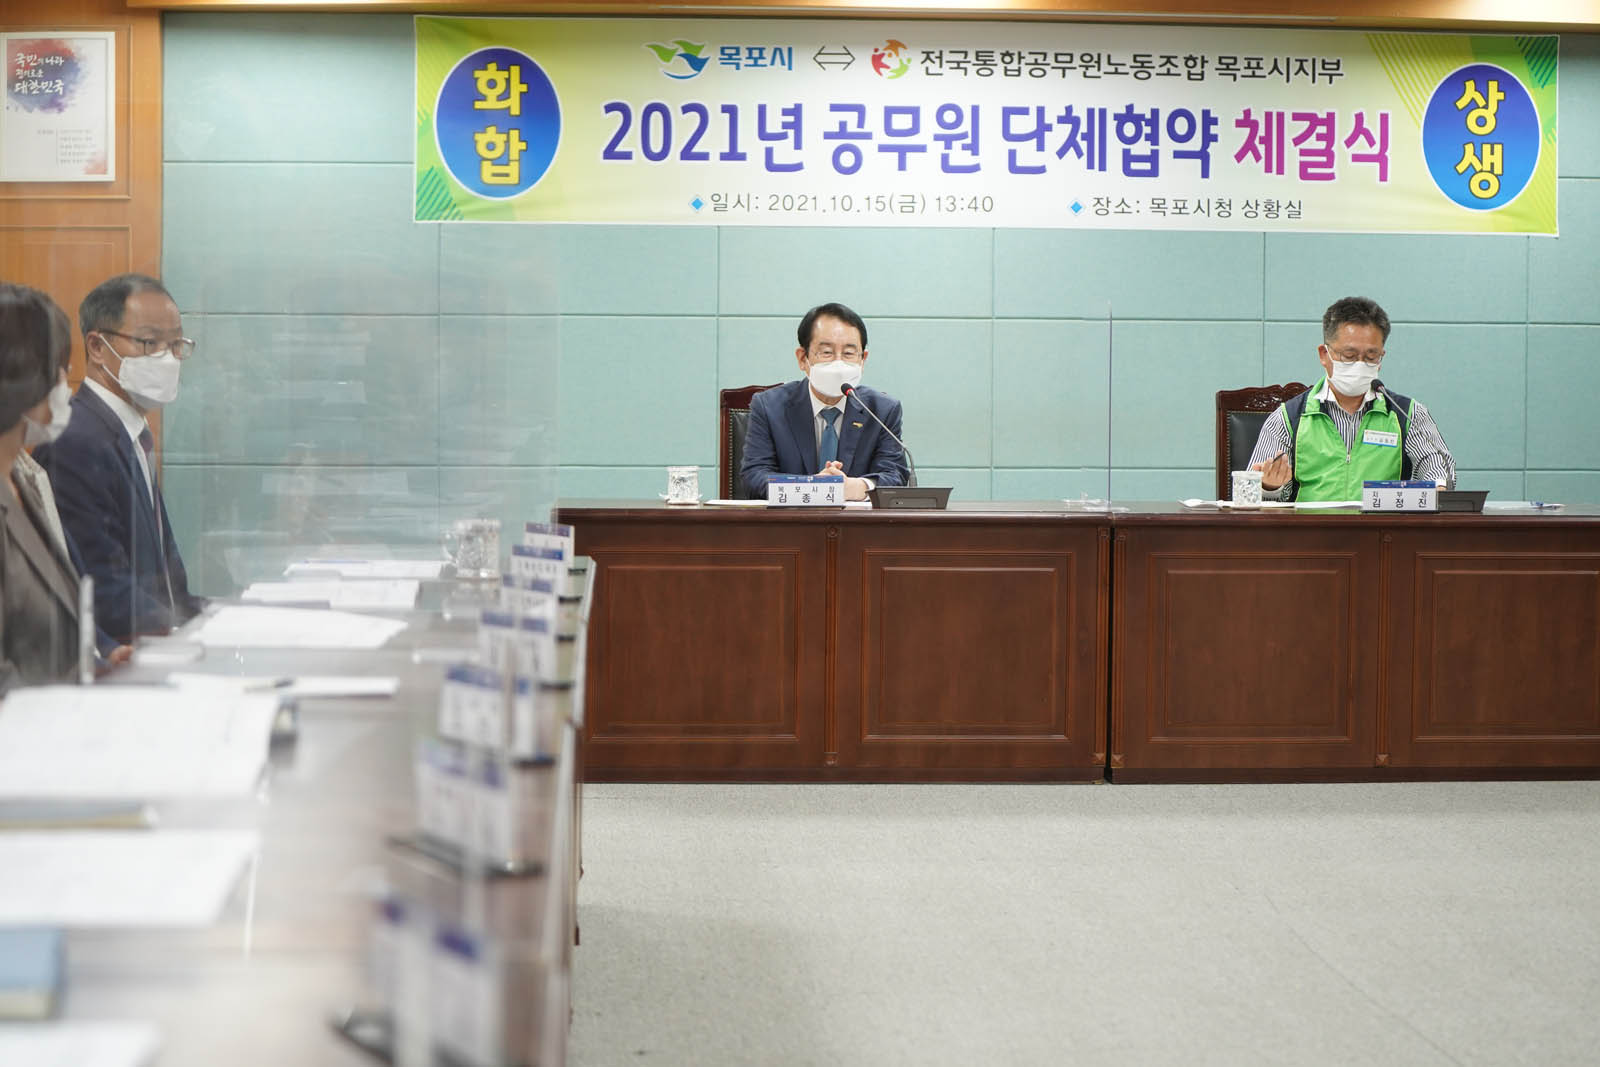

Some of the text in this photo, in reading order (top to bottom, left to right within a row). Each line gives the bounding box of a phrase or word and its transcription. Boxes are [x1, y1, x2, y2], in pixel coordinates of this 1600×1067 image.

[45, 55, 65, 66] 나라
[718, 45, 793, 73] 목포시
[920, 48, 1344, 86] 전국통합공무원노동조합 목포시지부
[13, 79, 65, 95] 대한민국
[473, 62, 528, 186] 화합
[601, 101, 1392, 183] 2021년 공무원 단체협약 체결식
[1455, 79, 1505, 200] 상생
[711, 192, 995, 215] 일시: 2021.10.15(금) 13:40
[1092, 196, 1304, 220] 장소: 목포시청 상황실
[778, 493, 835, 503] 김종식
[1372, 498, 1427, 508] 김정진
